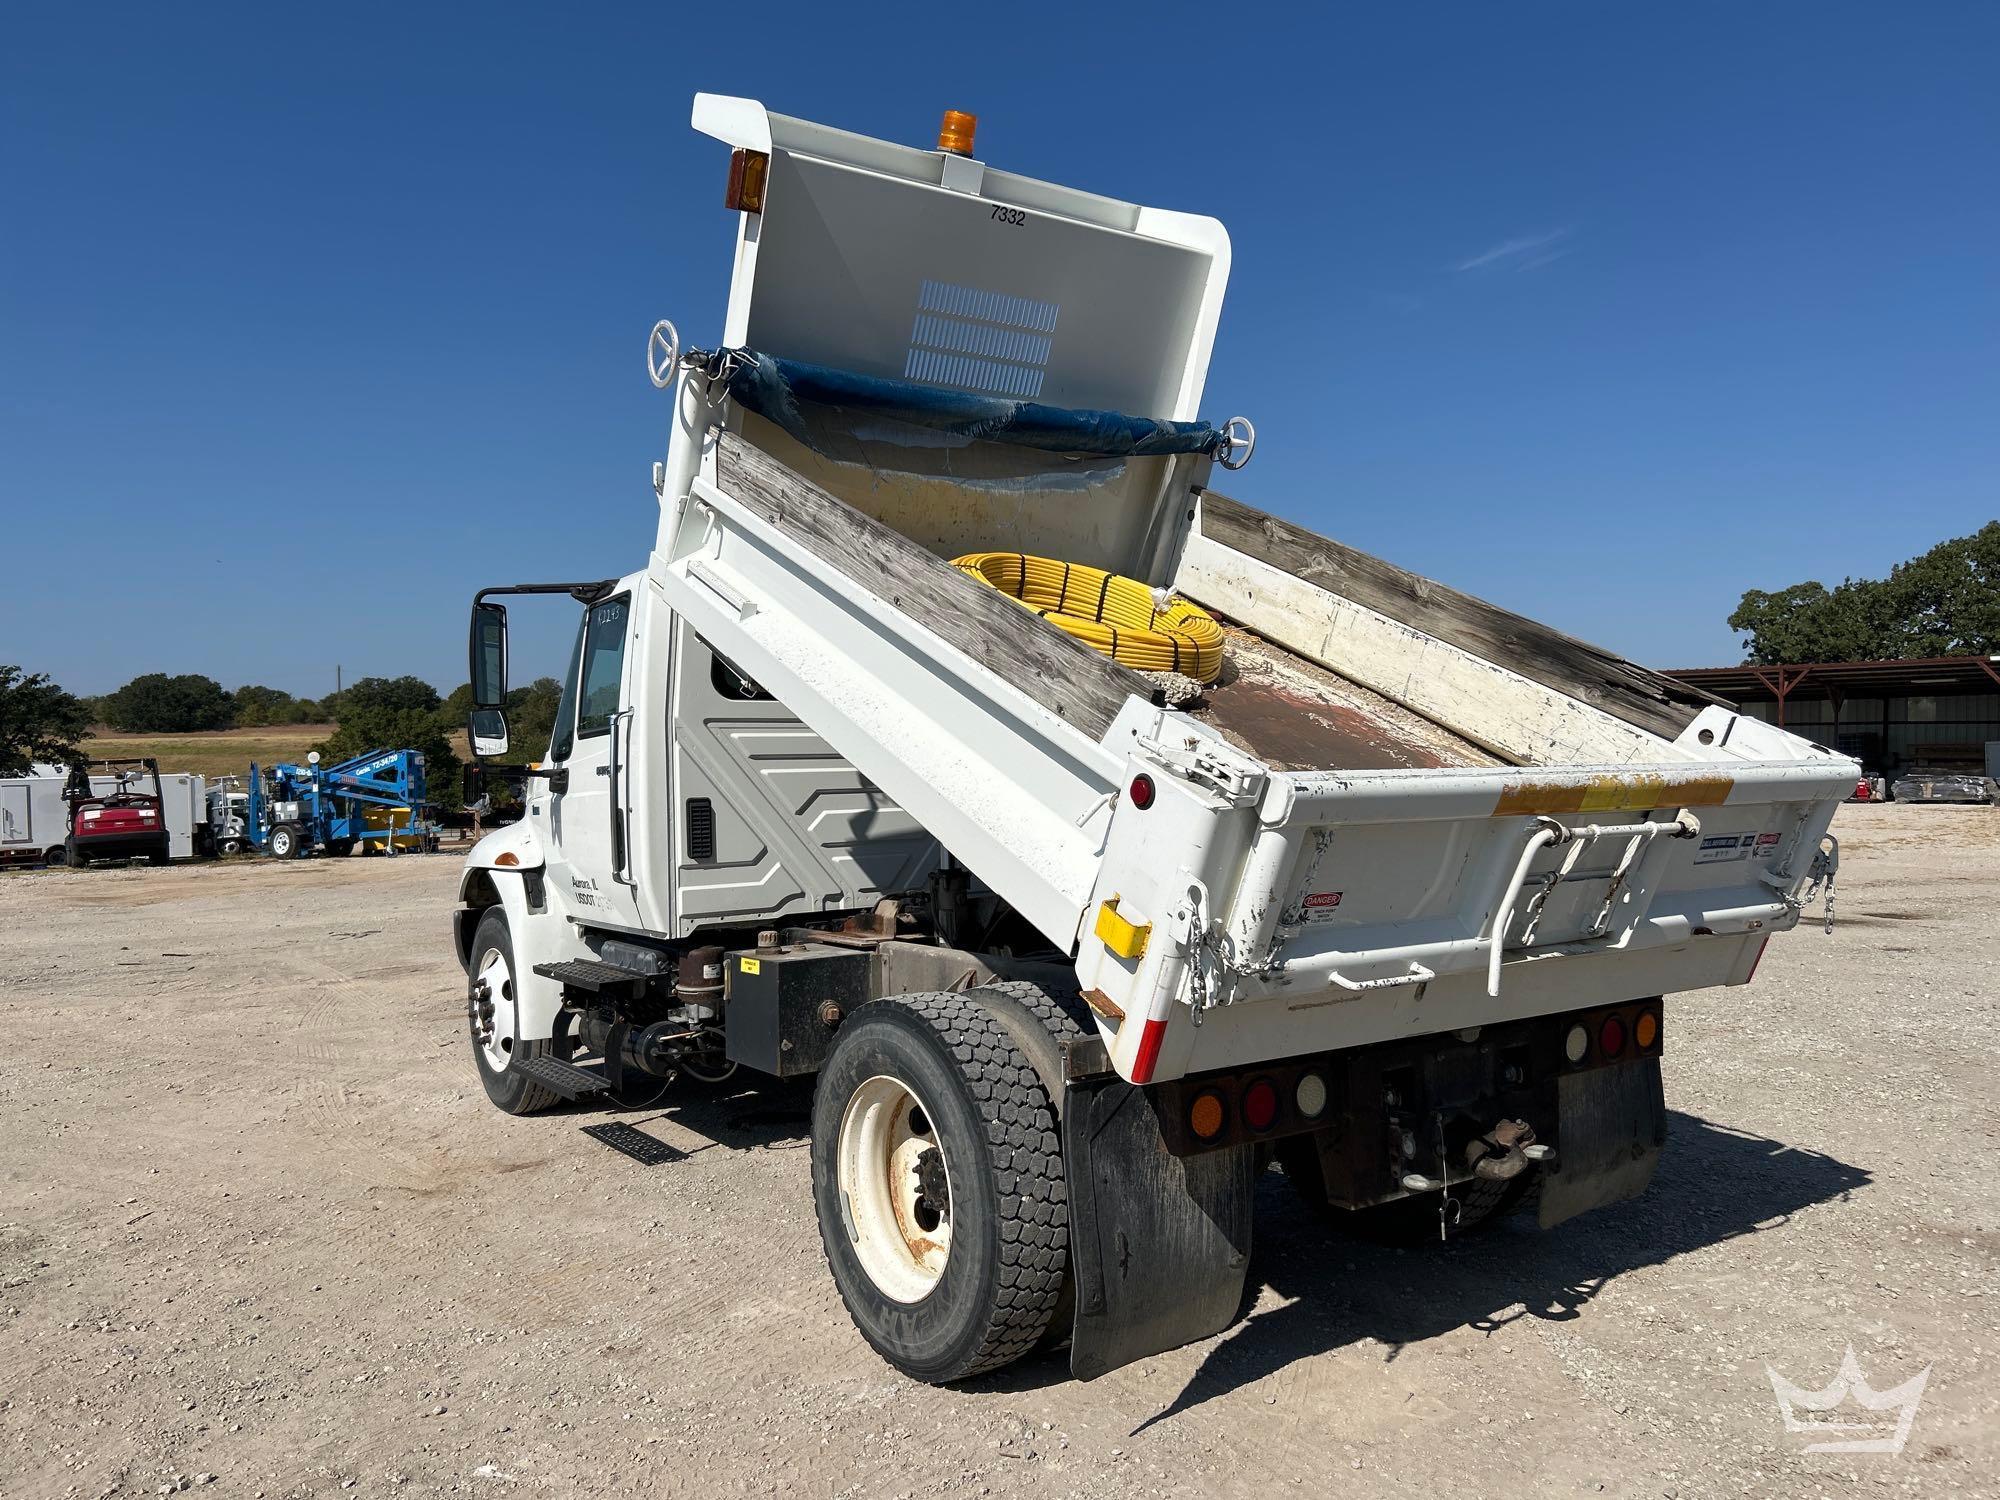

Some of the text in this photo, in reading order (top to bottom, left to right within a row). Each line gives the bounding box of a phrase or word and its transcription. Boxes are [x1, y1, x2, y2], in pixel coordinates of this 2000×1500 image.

[991, 203, 1026, 227] 7332
[591, 878, 599, 890] IL
[575, 891, 596, 907] USDOT
[1306, 895, 1338, 905] DANGER
